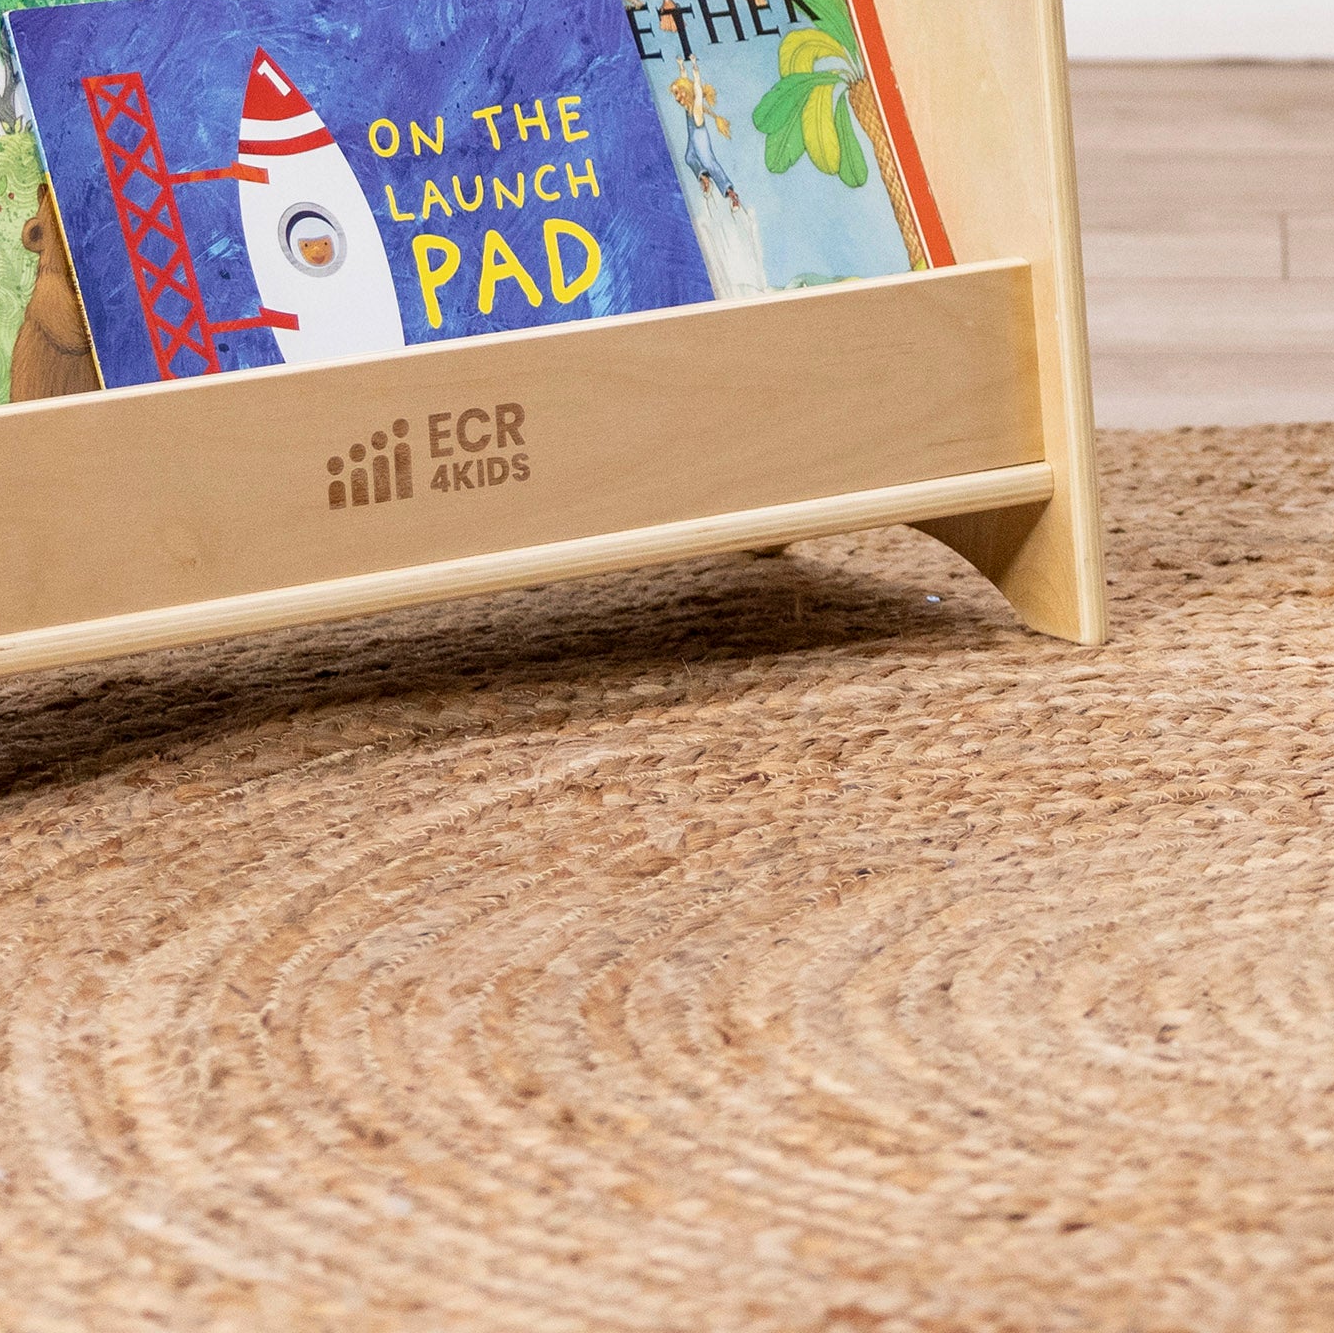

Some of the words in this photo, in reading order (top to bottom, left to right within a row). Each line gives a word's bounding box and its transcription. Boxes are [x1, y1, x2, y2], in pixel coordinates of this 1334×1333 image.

[256, 59, 292, 97] 1
[367, 115, 445, 159] ON
[471, 95, 590, 151] THE
[384, 158, 601, 222] LAUNCH
[411, 217, 603, 330] PAD
[427, 402, 527, 459] ECR
[429, 452, 532, 493] 4KIDS
